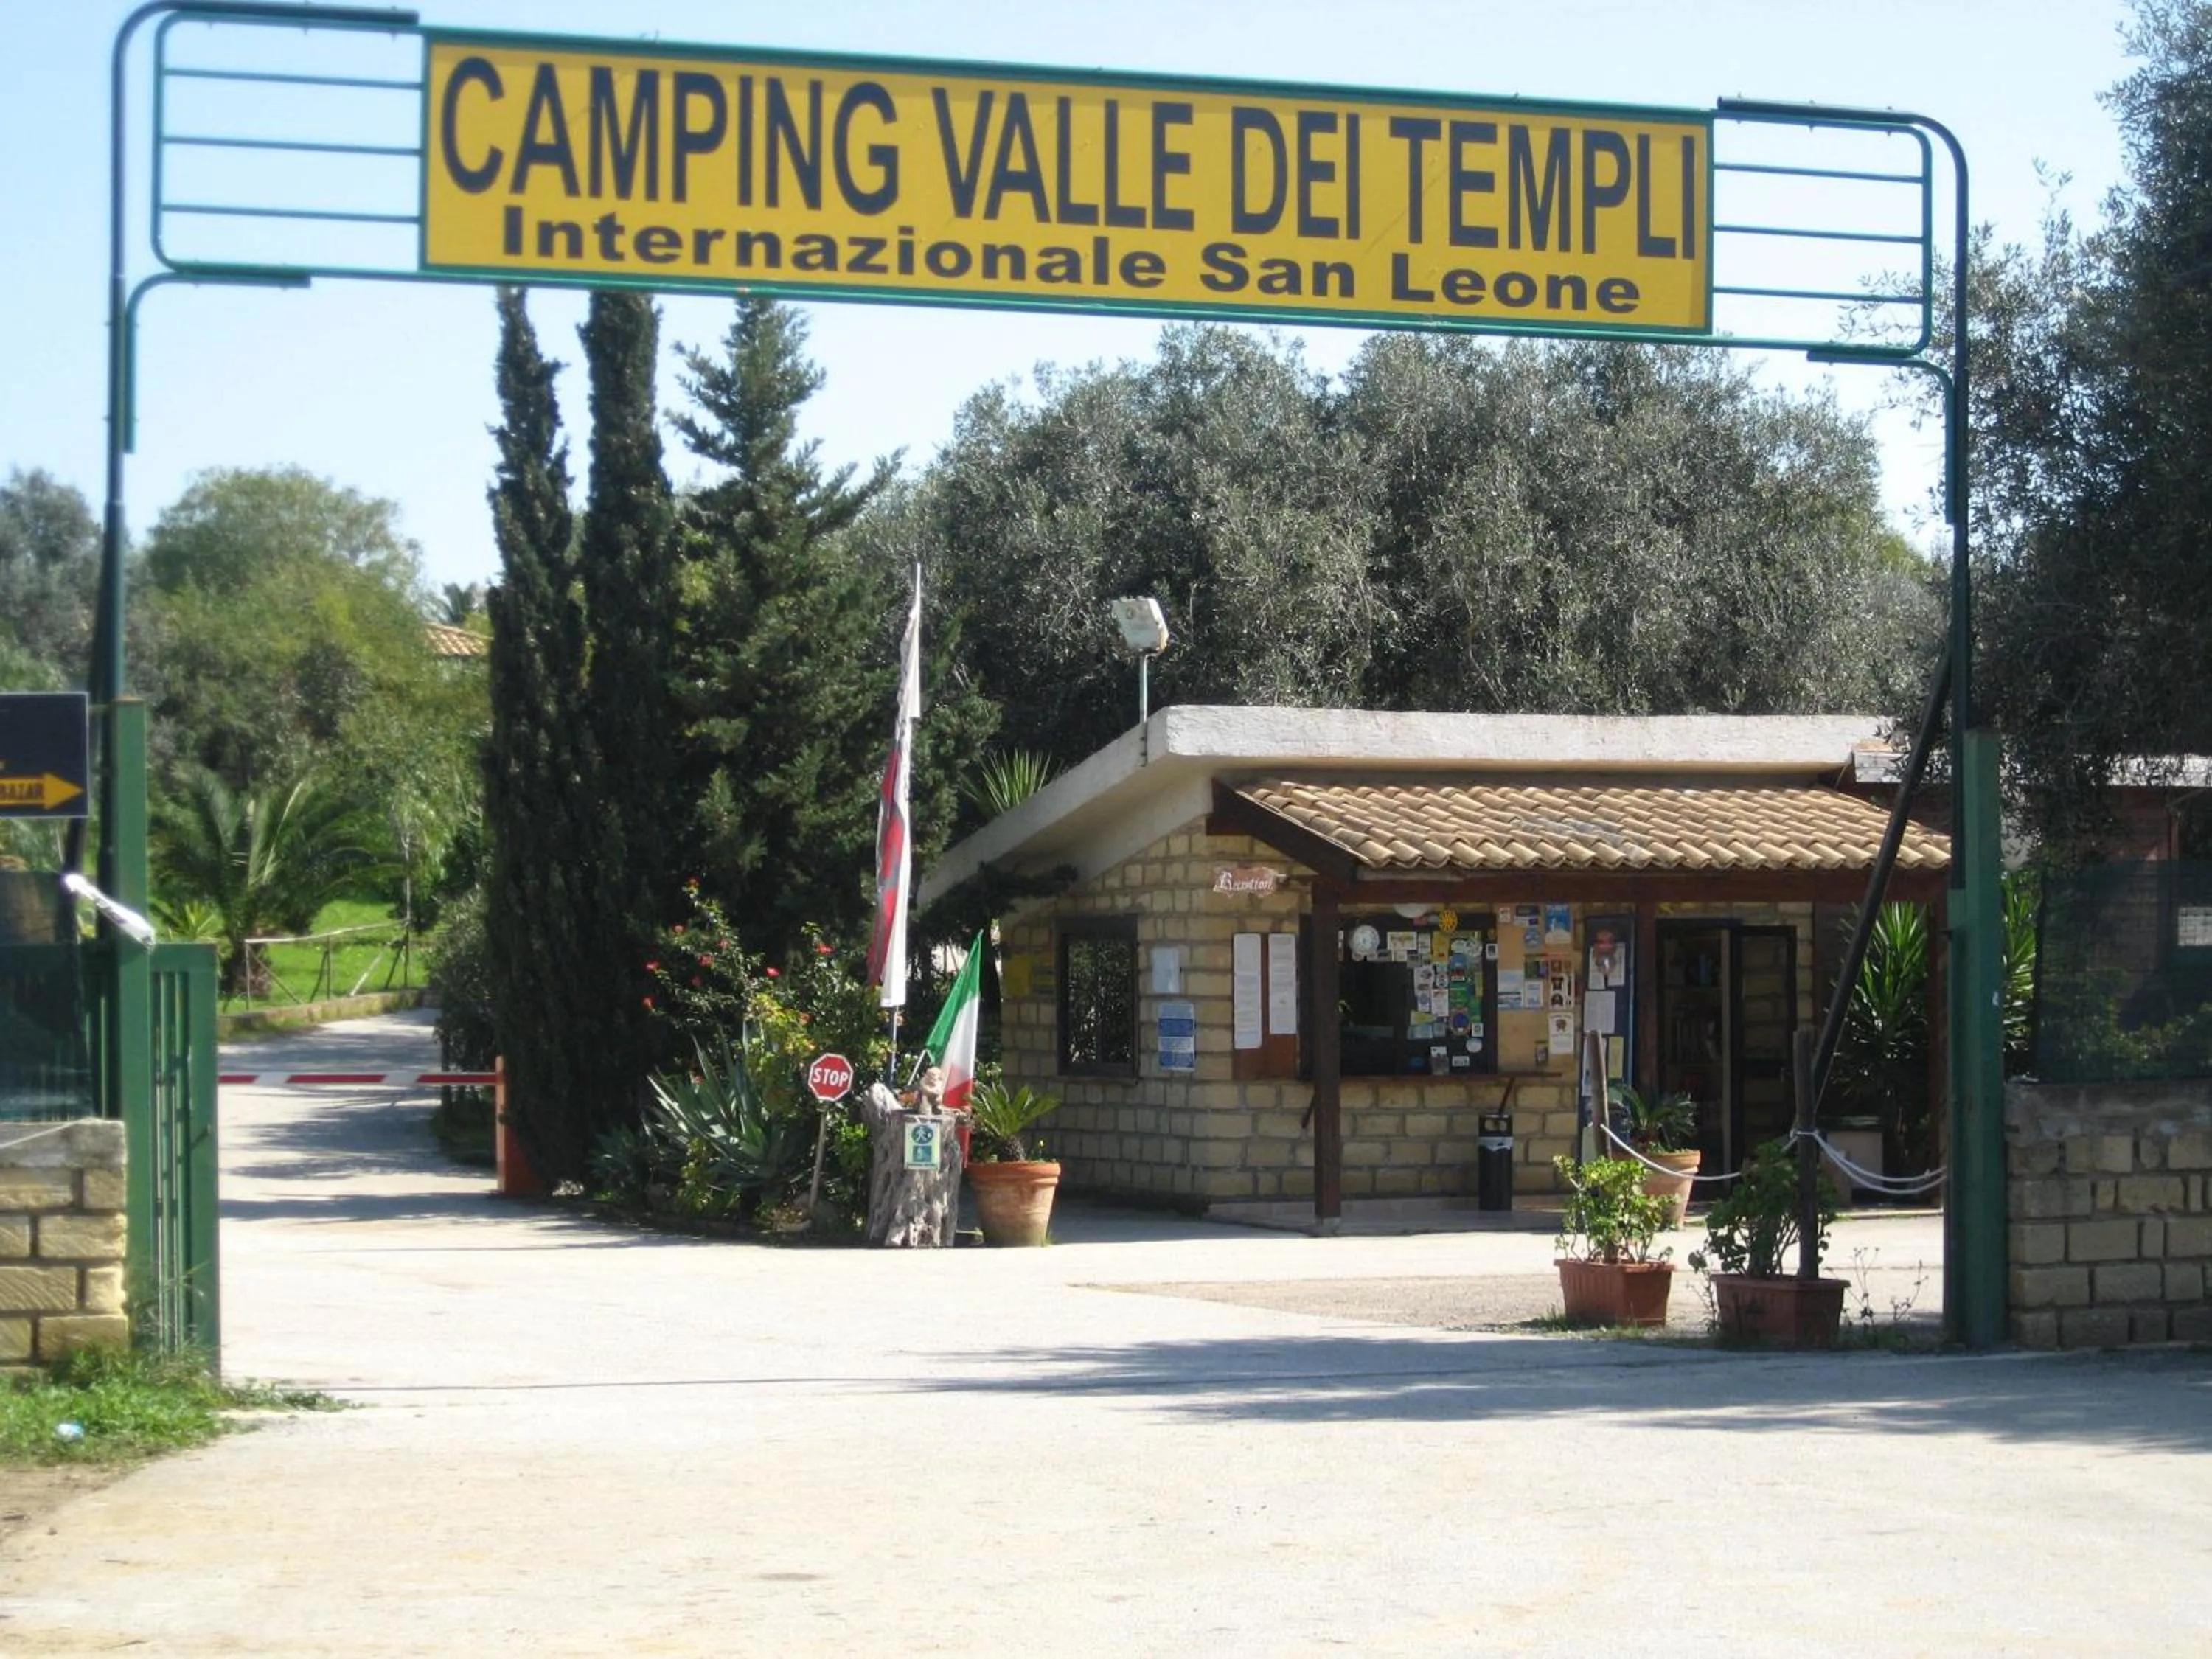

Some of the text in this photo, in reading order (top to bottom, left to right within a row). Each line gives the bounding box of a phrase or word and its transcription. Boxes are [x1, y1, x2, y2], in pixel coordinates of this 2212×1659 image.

[441, 55, 1696, 260] CAMPING VALLE DEI TEMPLI
[504, 205, 1640, 313] Internazionale San Leone
[813, 1067, 849, 1088] STOP
